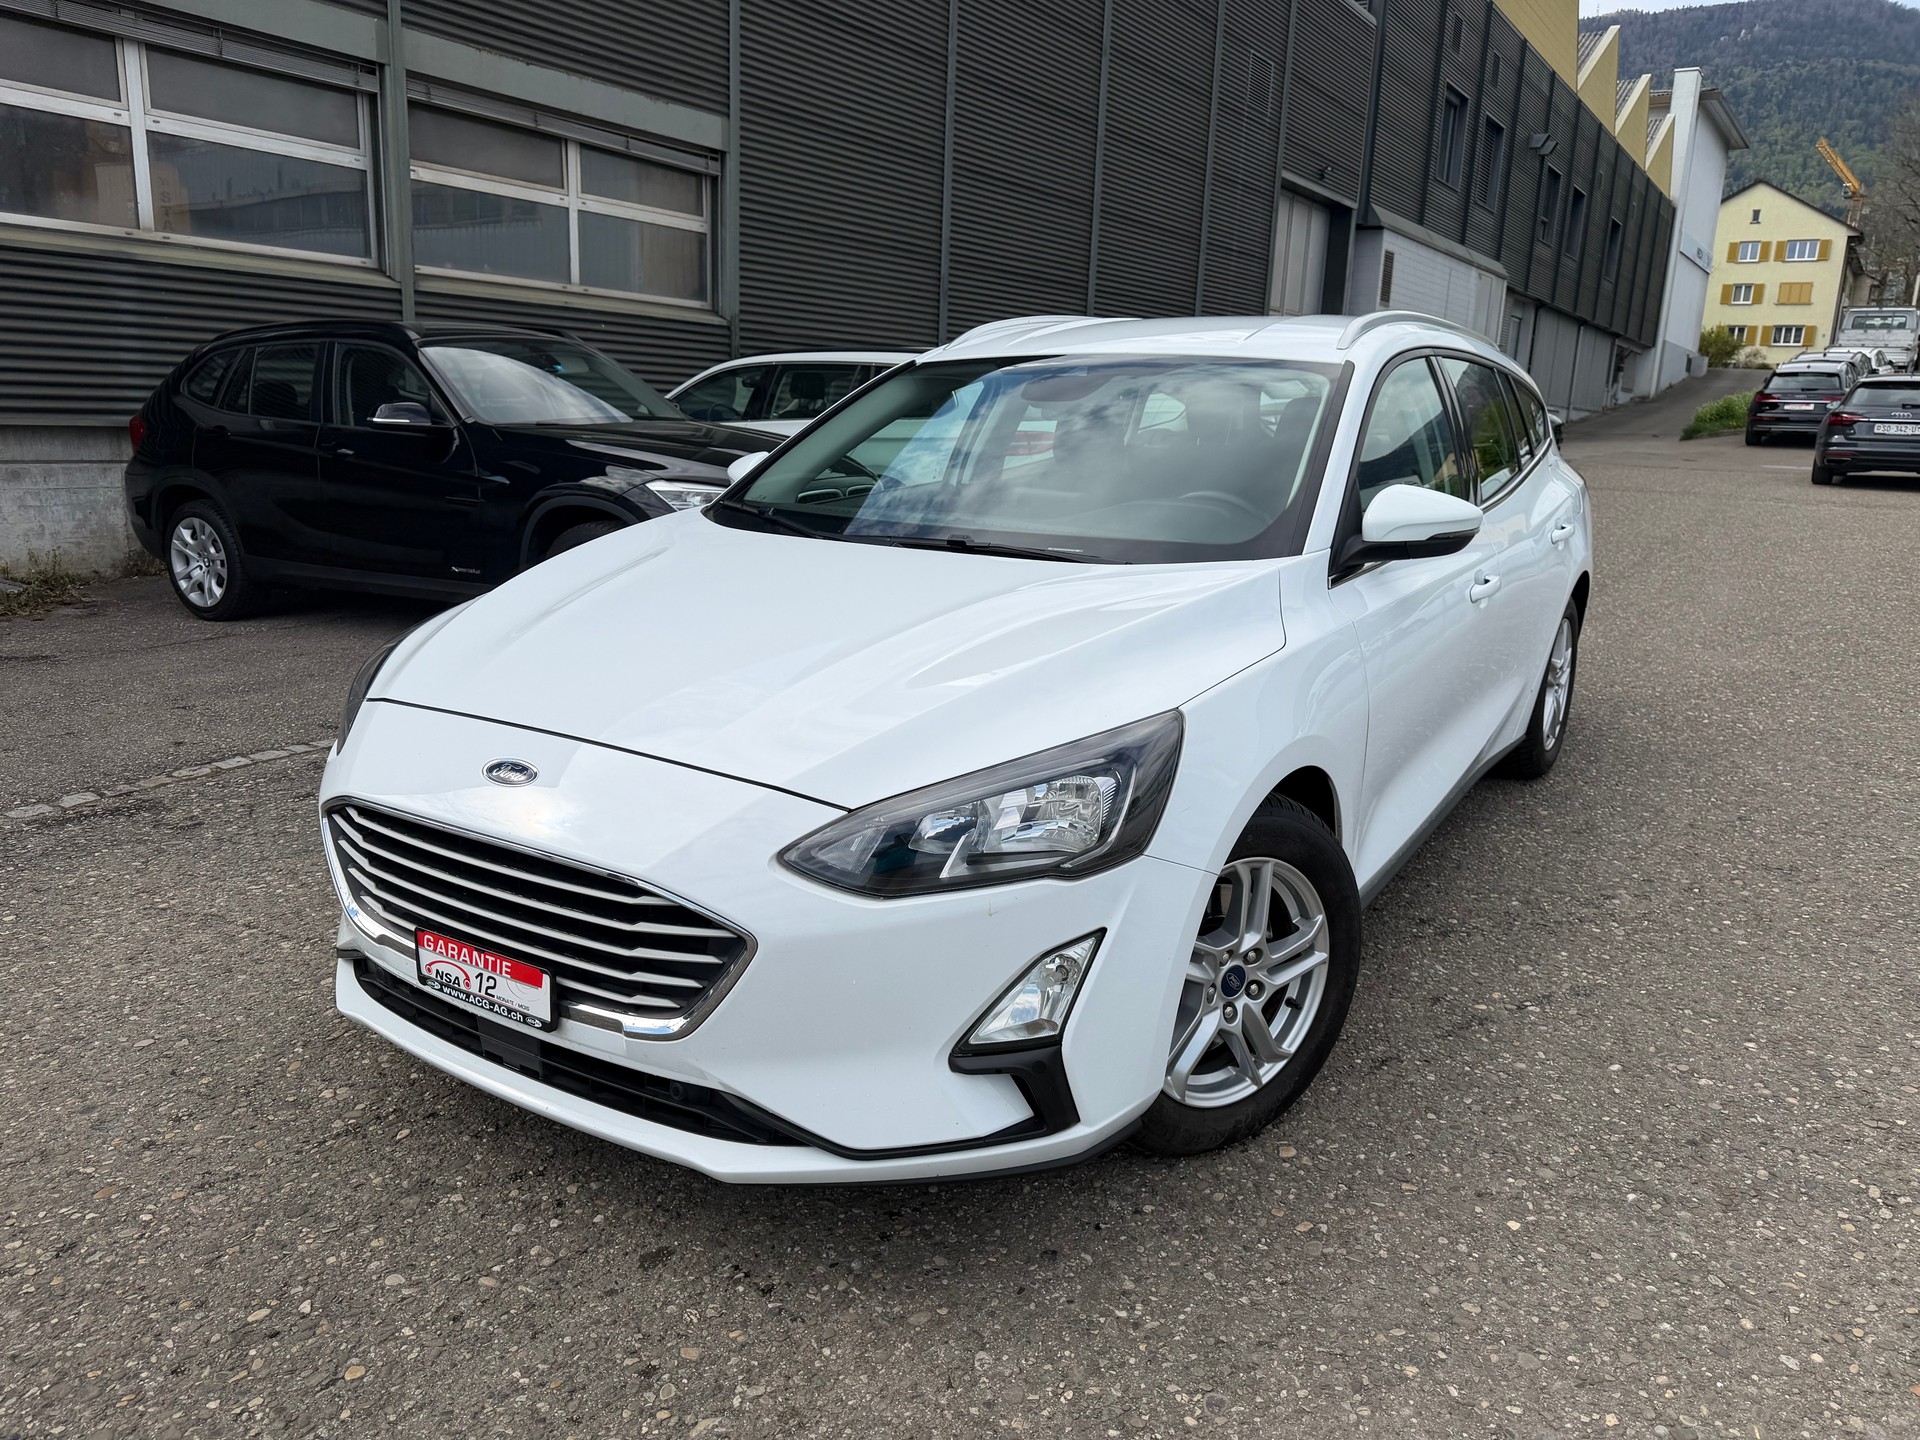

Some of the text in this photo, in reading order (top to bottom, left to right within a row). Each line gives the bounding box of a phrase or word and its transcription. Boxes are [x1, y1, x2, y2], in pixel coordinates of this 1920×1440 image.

[424, 935, 512, 978] GARANTIE
[435, 969, 461, 987] NSA
[475, 972, 497, 999] 12
[442, 985, 524, 1022] www.ACG-AG.ch
